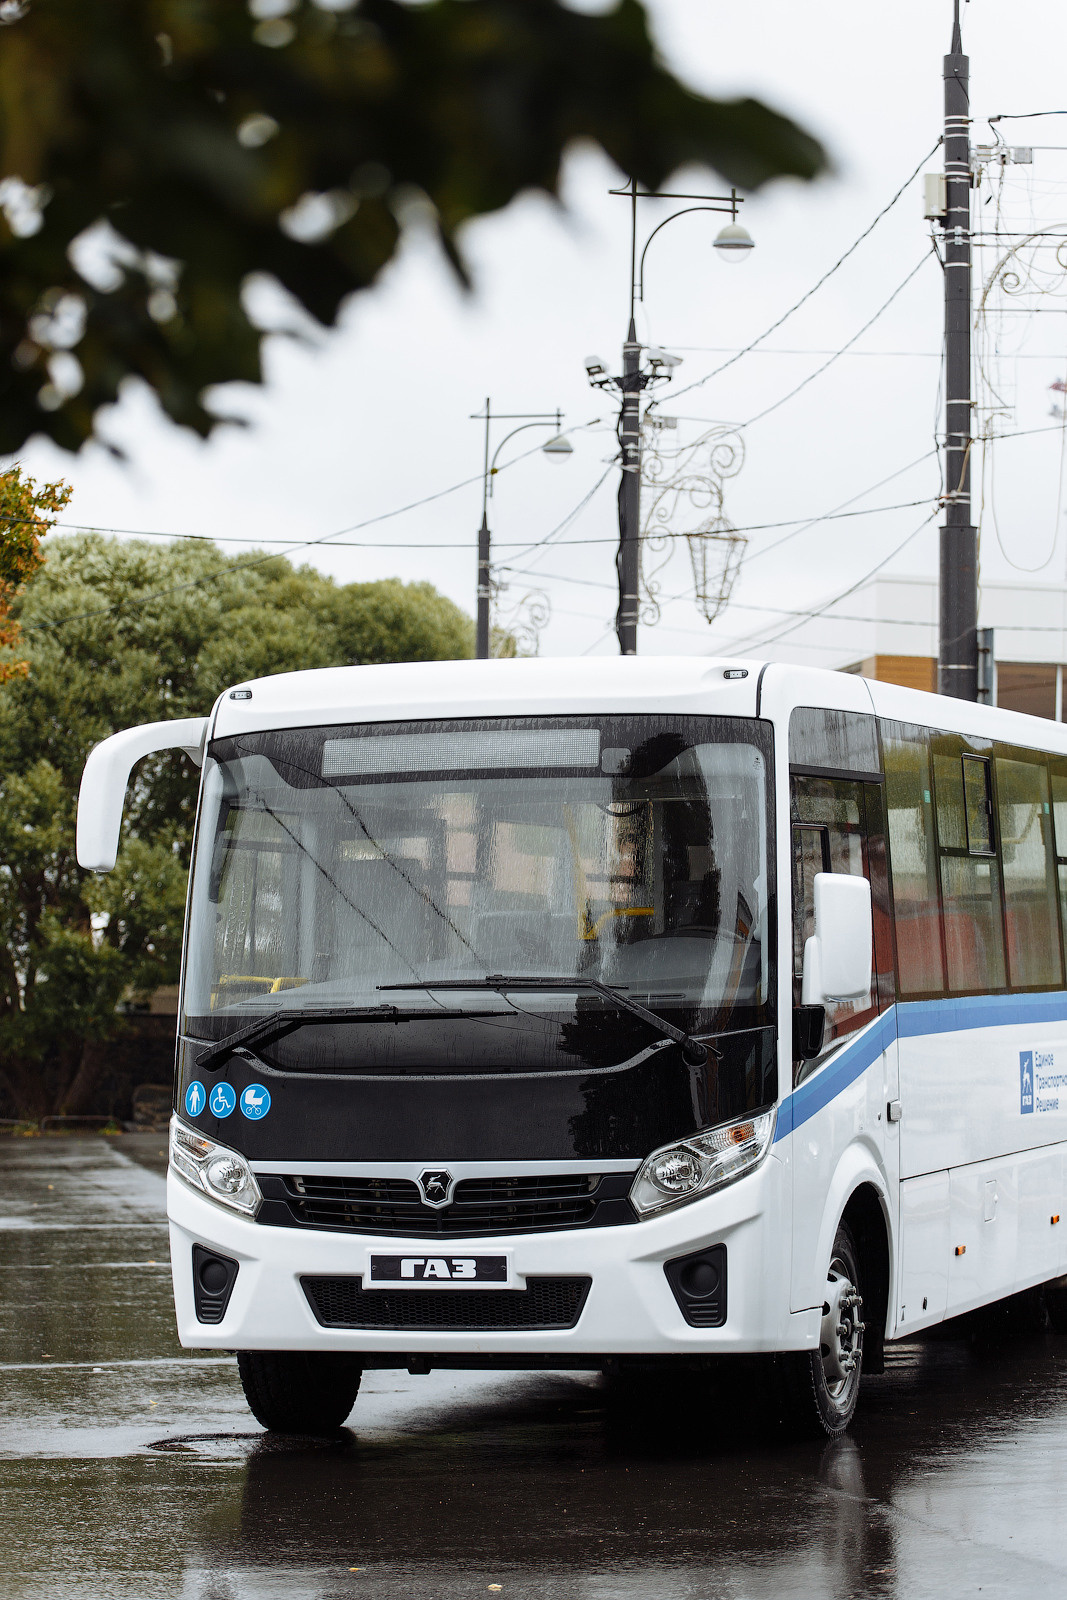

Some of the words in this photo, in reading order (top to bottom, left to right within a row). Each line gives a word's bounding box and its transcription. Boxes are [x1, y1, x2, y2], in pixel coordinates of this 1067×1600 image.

[1035, 1051, 1053, 1068] Единое
[1022, 1095, 1032, 1106] ГАЗ
[1036, 1097, 1058, 1112] Решение
[401, 1259, 476, 1278] ГАЗ
